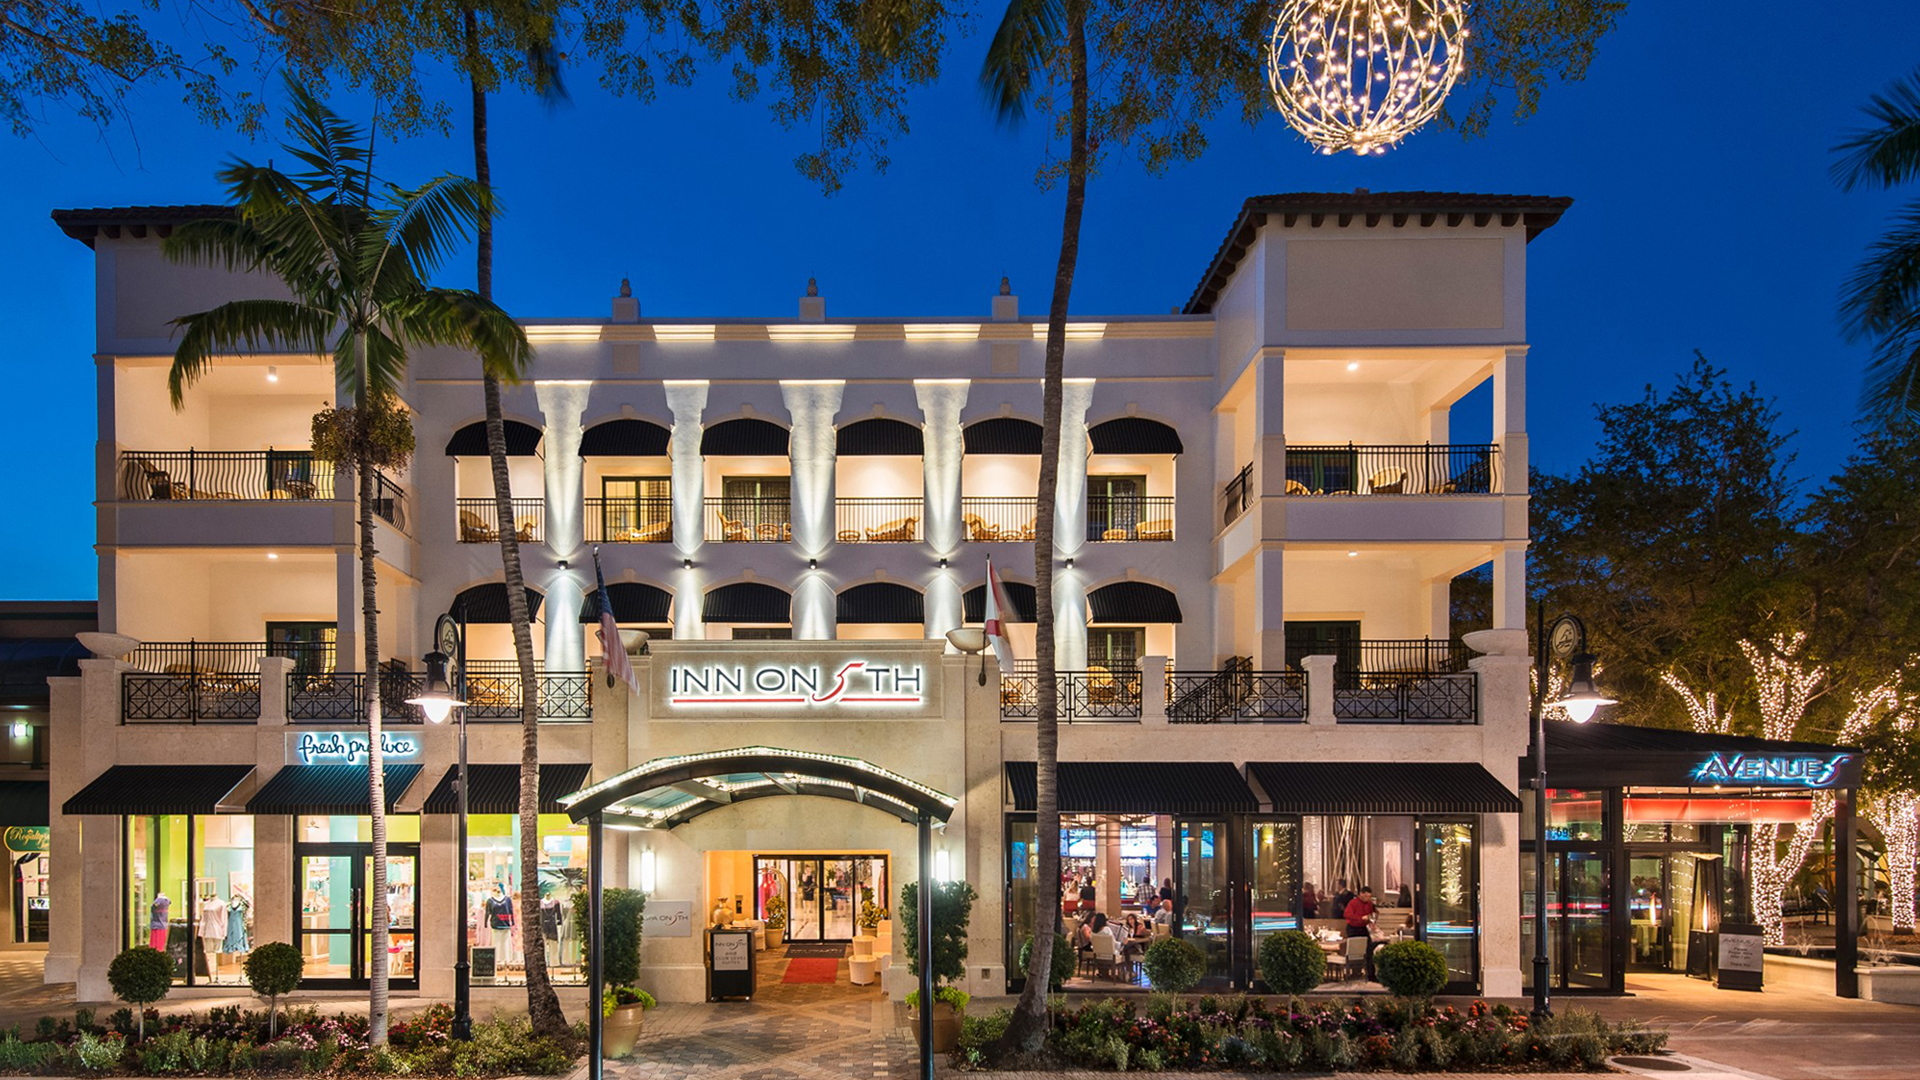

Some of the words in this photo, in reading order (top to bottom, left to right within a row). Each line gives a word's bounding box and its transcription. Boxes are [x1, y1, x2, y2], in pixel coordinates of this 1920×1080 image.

[672, 668, 742, 693] INN
[755, 668, 817, 693] ON
[812, 662, 920, 702] 5TH
[299, 734, 345, 762] fresh
[347, 734, 414, 761] pruce
